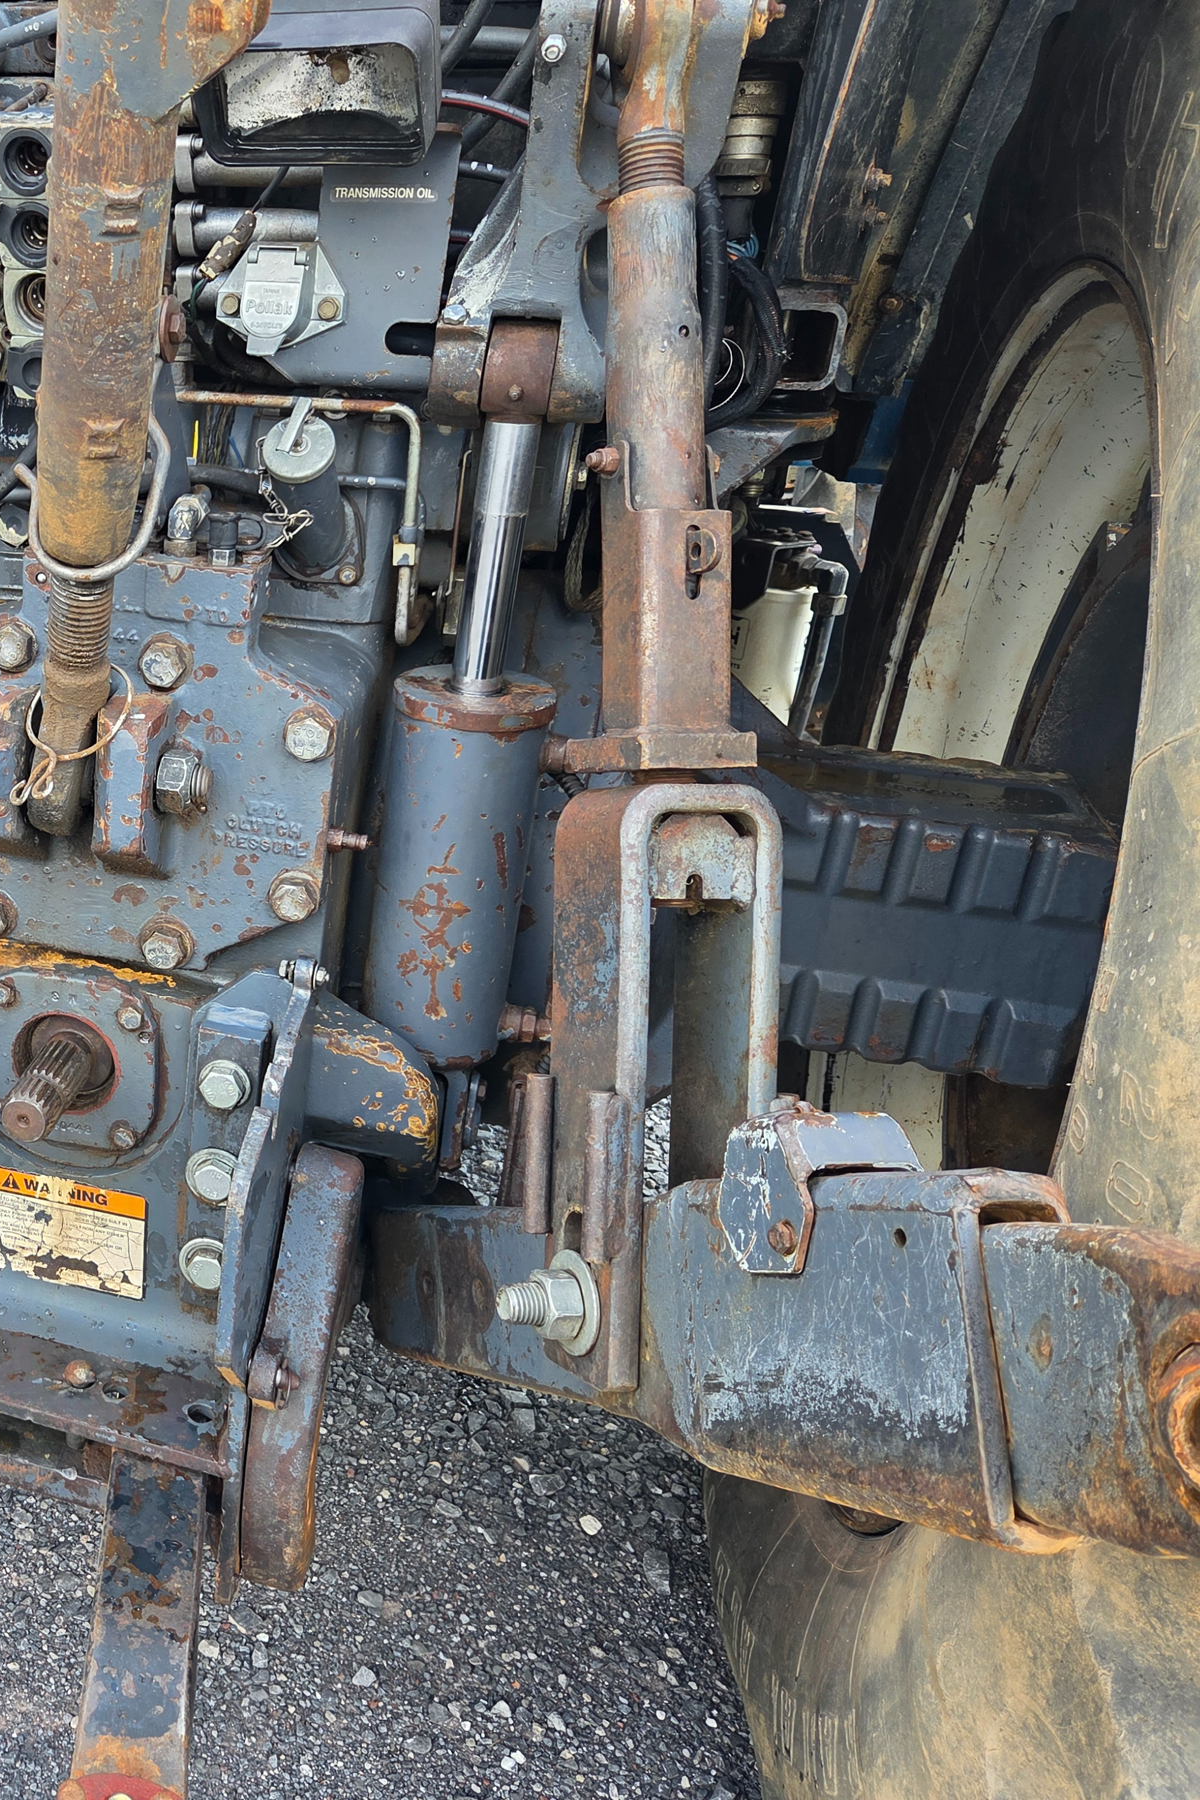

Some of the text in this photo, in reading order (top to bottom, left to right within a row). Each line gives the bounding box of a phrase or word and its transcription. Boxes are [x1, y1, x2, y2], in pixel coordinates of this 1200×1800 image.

[335, 187, 435, 200] TRANSMISSION OIL
[245, 299, 293, 316] Pollak
[246, 800, 287, 821] PTO
[226, 813, 302, 840] CLUTCH
[214, 826, 310, 857] PRESSURE
[23, 1178, 108, 1206] WANING
